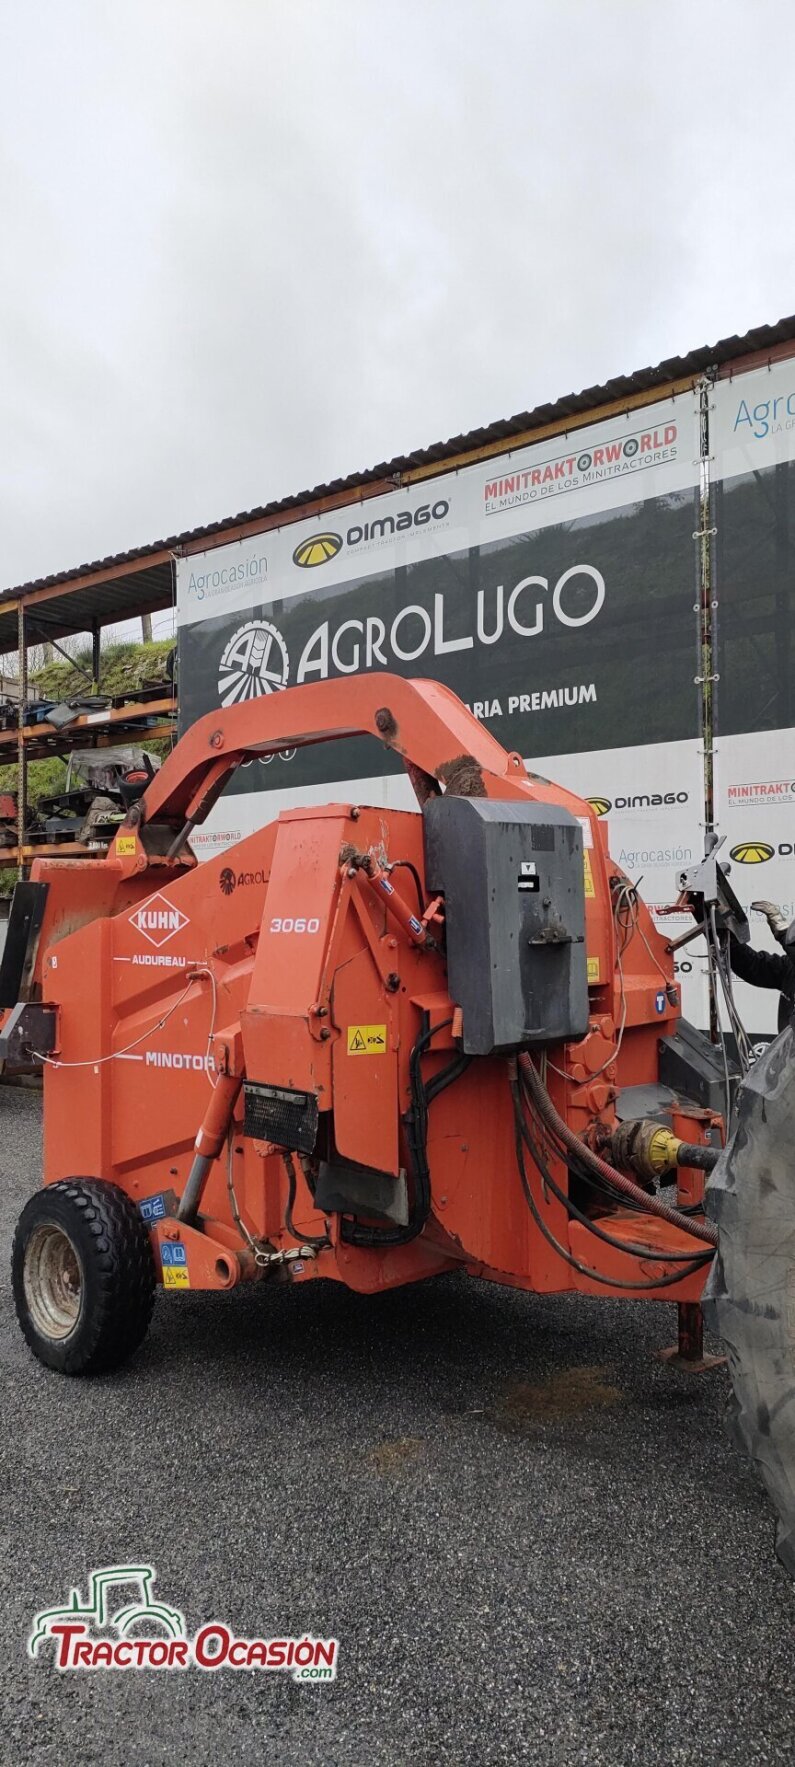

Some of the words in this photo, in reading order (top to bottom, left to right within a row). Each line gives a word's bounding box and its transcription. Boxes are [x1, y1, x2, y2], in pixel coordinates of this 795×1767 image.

[484, 425, 678, 501] MINITRAKTORWORLD
[485, 502, 497, 512] EL
[500, 489, 538, 508] MUNDO
[541, 484, 555, 497] DE
[558, 477, 579, 491] LOS
[188, 554, 268, 601] Agrocasión
[508, 683, 598, 715] PREMIUM
[619, 845, 692, 869] Agrocasión
[137, 911, 180, 930] KUHN
[270, 918, 320, 933] 3060
[132, 955, 186, 967] AUDUREAU
[145, 1052, 216, 1072] MINOTOR
